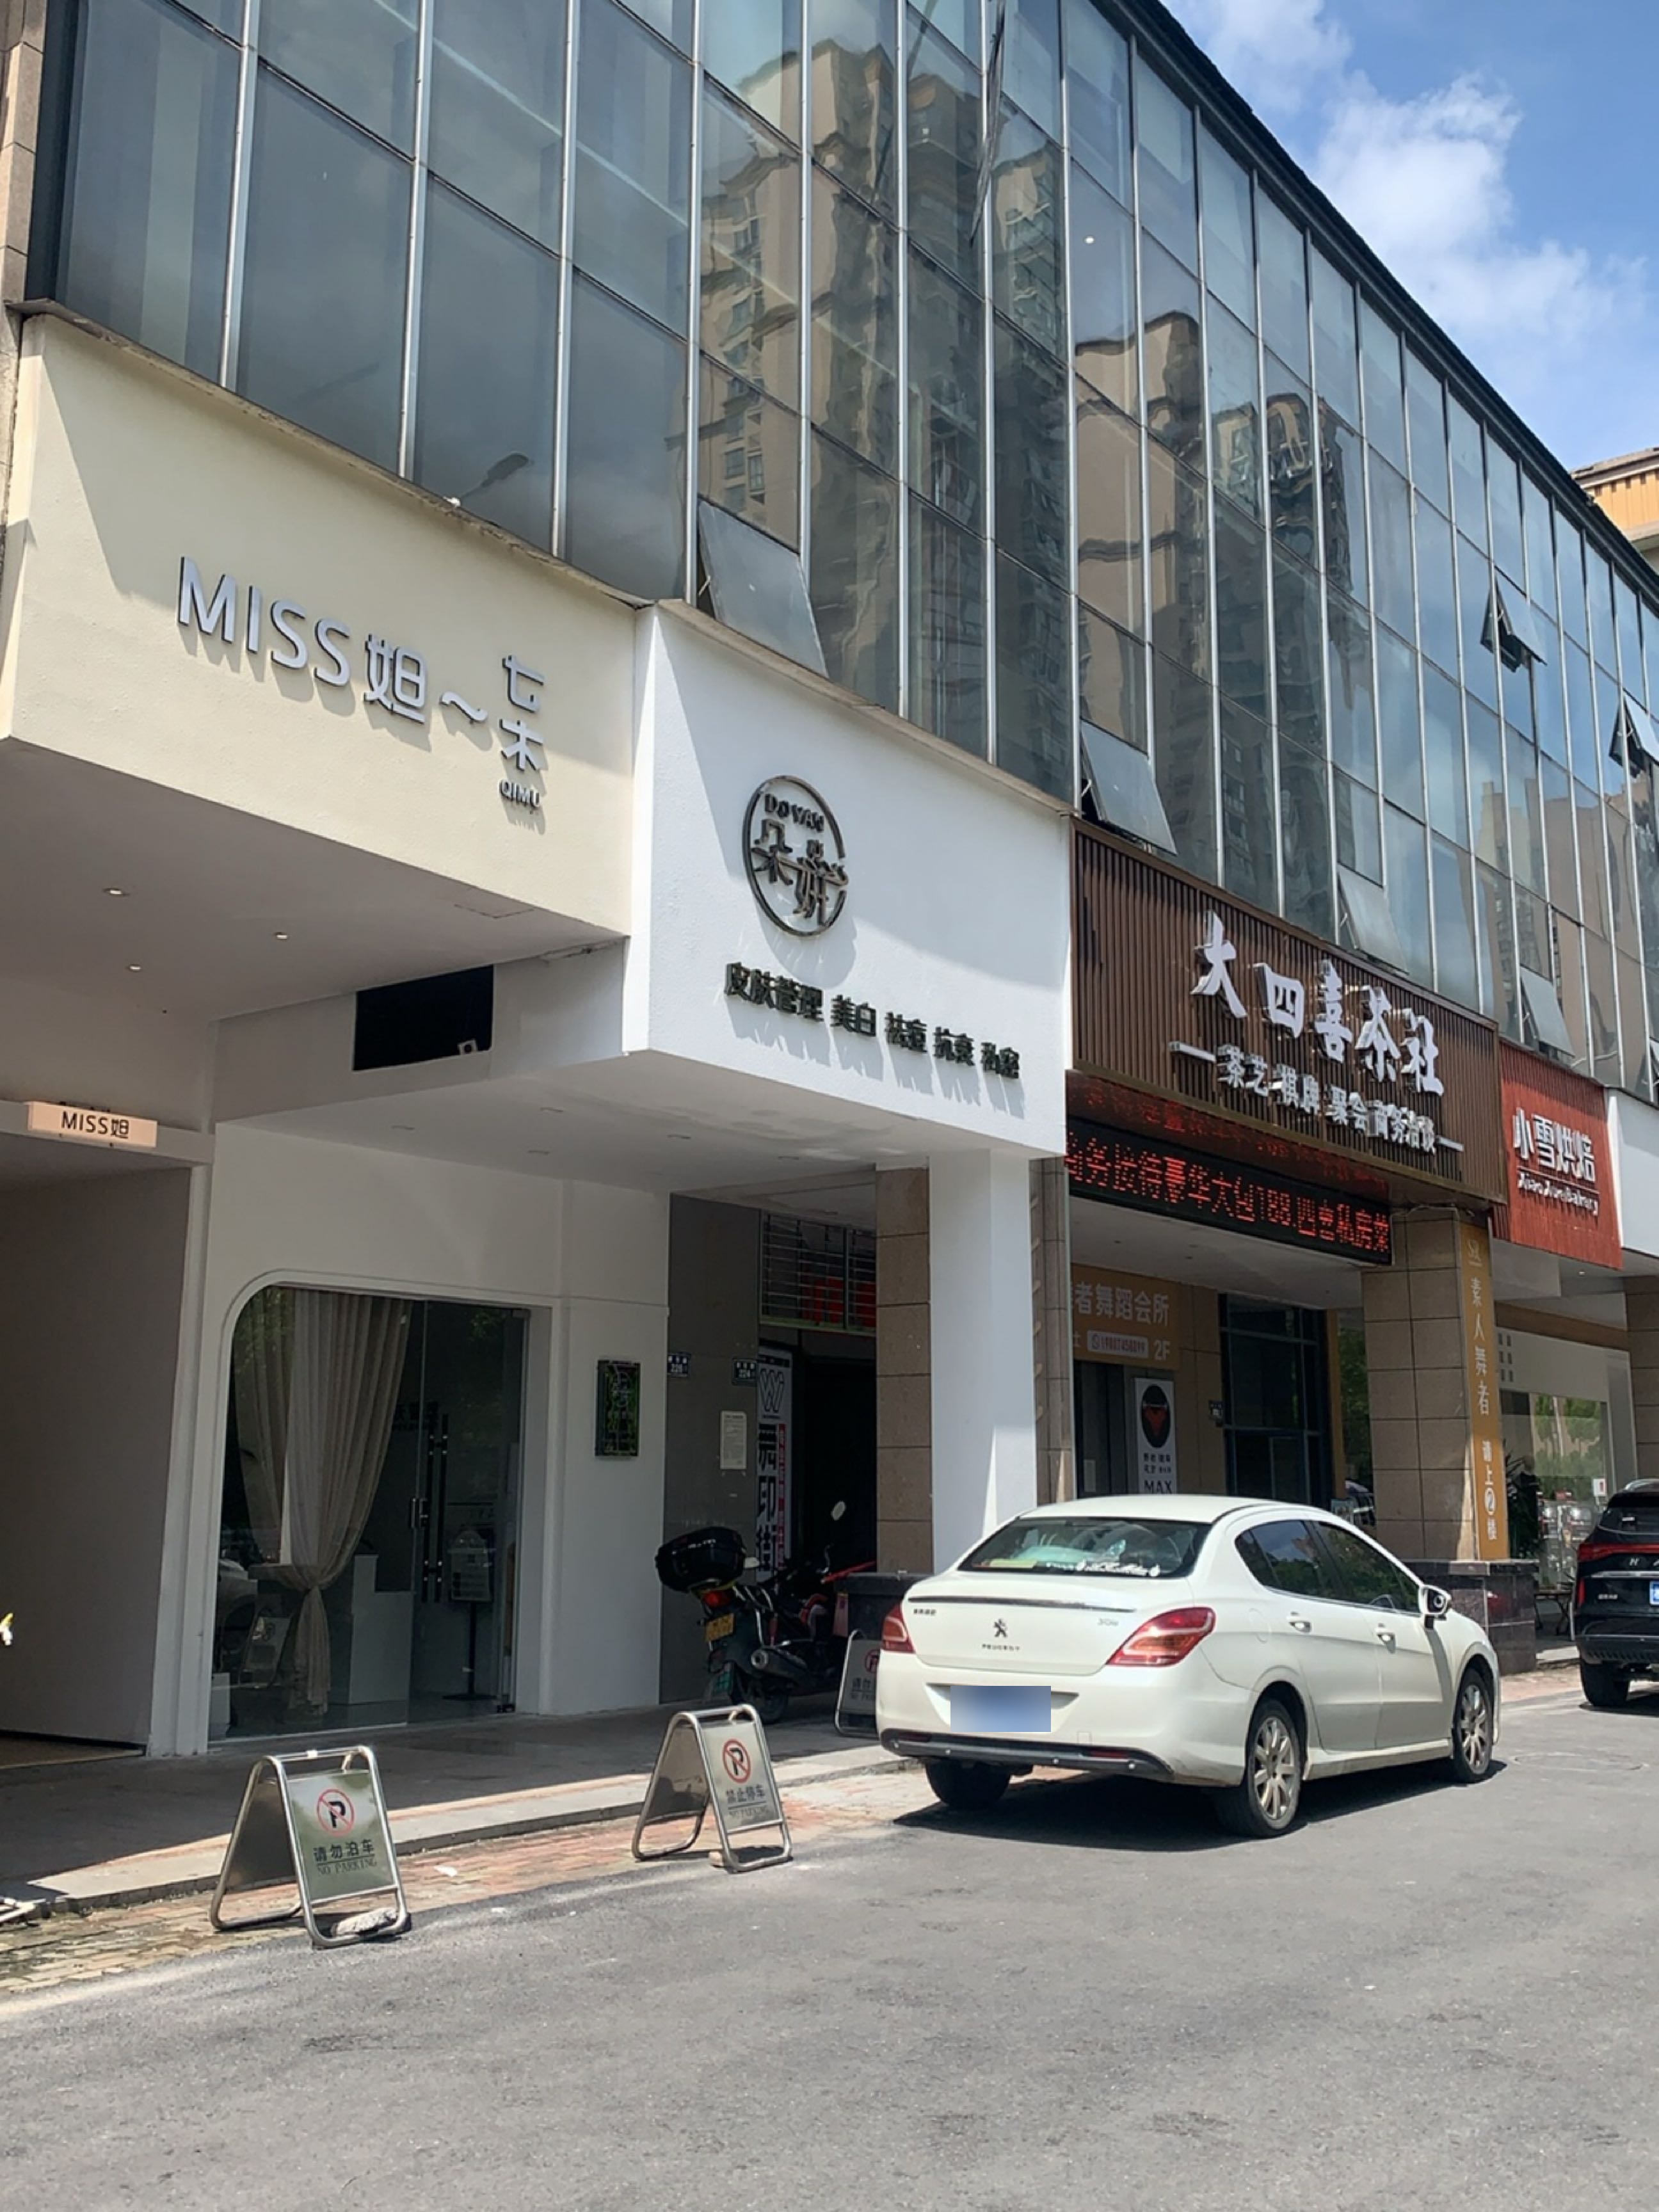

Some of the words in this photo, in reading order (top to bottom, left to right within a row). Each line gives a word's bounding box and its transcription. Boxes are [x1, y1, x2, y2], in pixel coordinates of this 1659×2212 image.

[499, 780, 540, 808] QIMU
[724, 961, 824, 1023] 皮肤管理
[830, 994, 877, 1037] 美白
[1217, 1043, 1269, 1097] 茶艺
[1270, 1064, 1320, 1116] 棋牌
[1071, 1281, 1169, 1327] 者舞蹈会所
[313, 1838, 374, 1861] 请勿泊车
